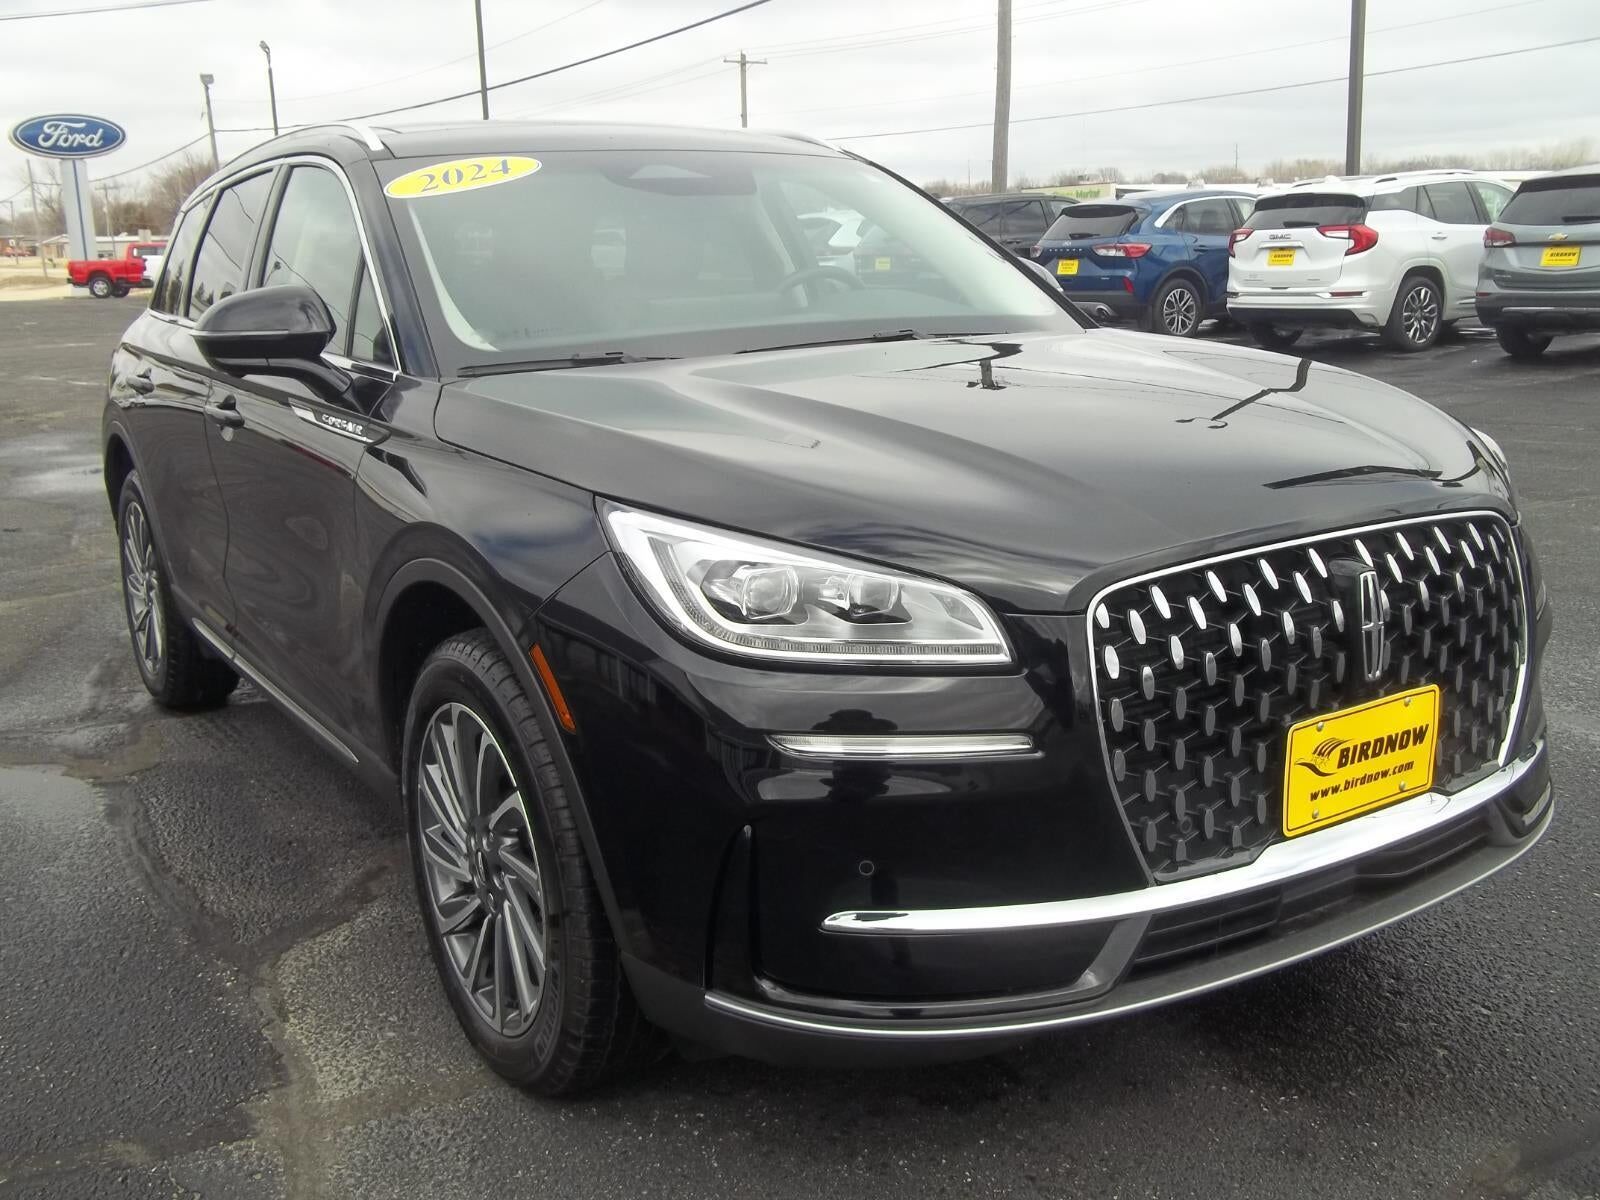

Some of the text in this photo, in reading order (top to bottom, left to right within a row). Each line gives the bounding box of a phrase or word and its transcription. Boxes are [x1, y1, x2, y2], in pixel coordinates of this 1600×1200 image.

[38, 121, 104, 148] Ford
[419, 159, 512, 193] 2024
[1336, 723, 1430, 770] BIRDNOW
[1310, 760, 1415, 802] www.birdnow.com
